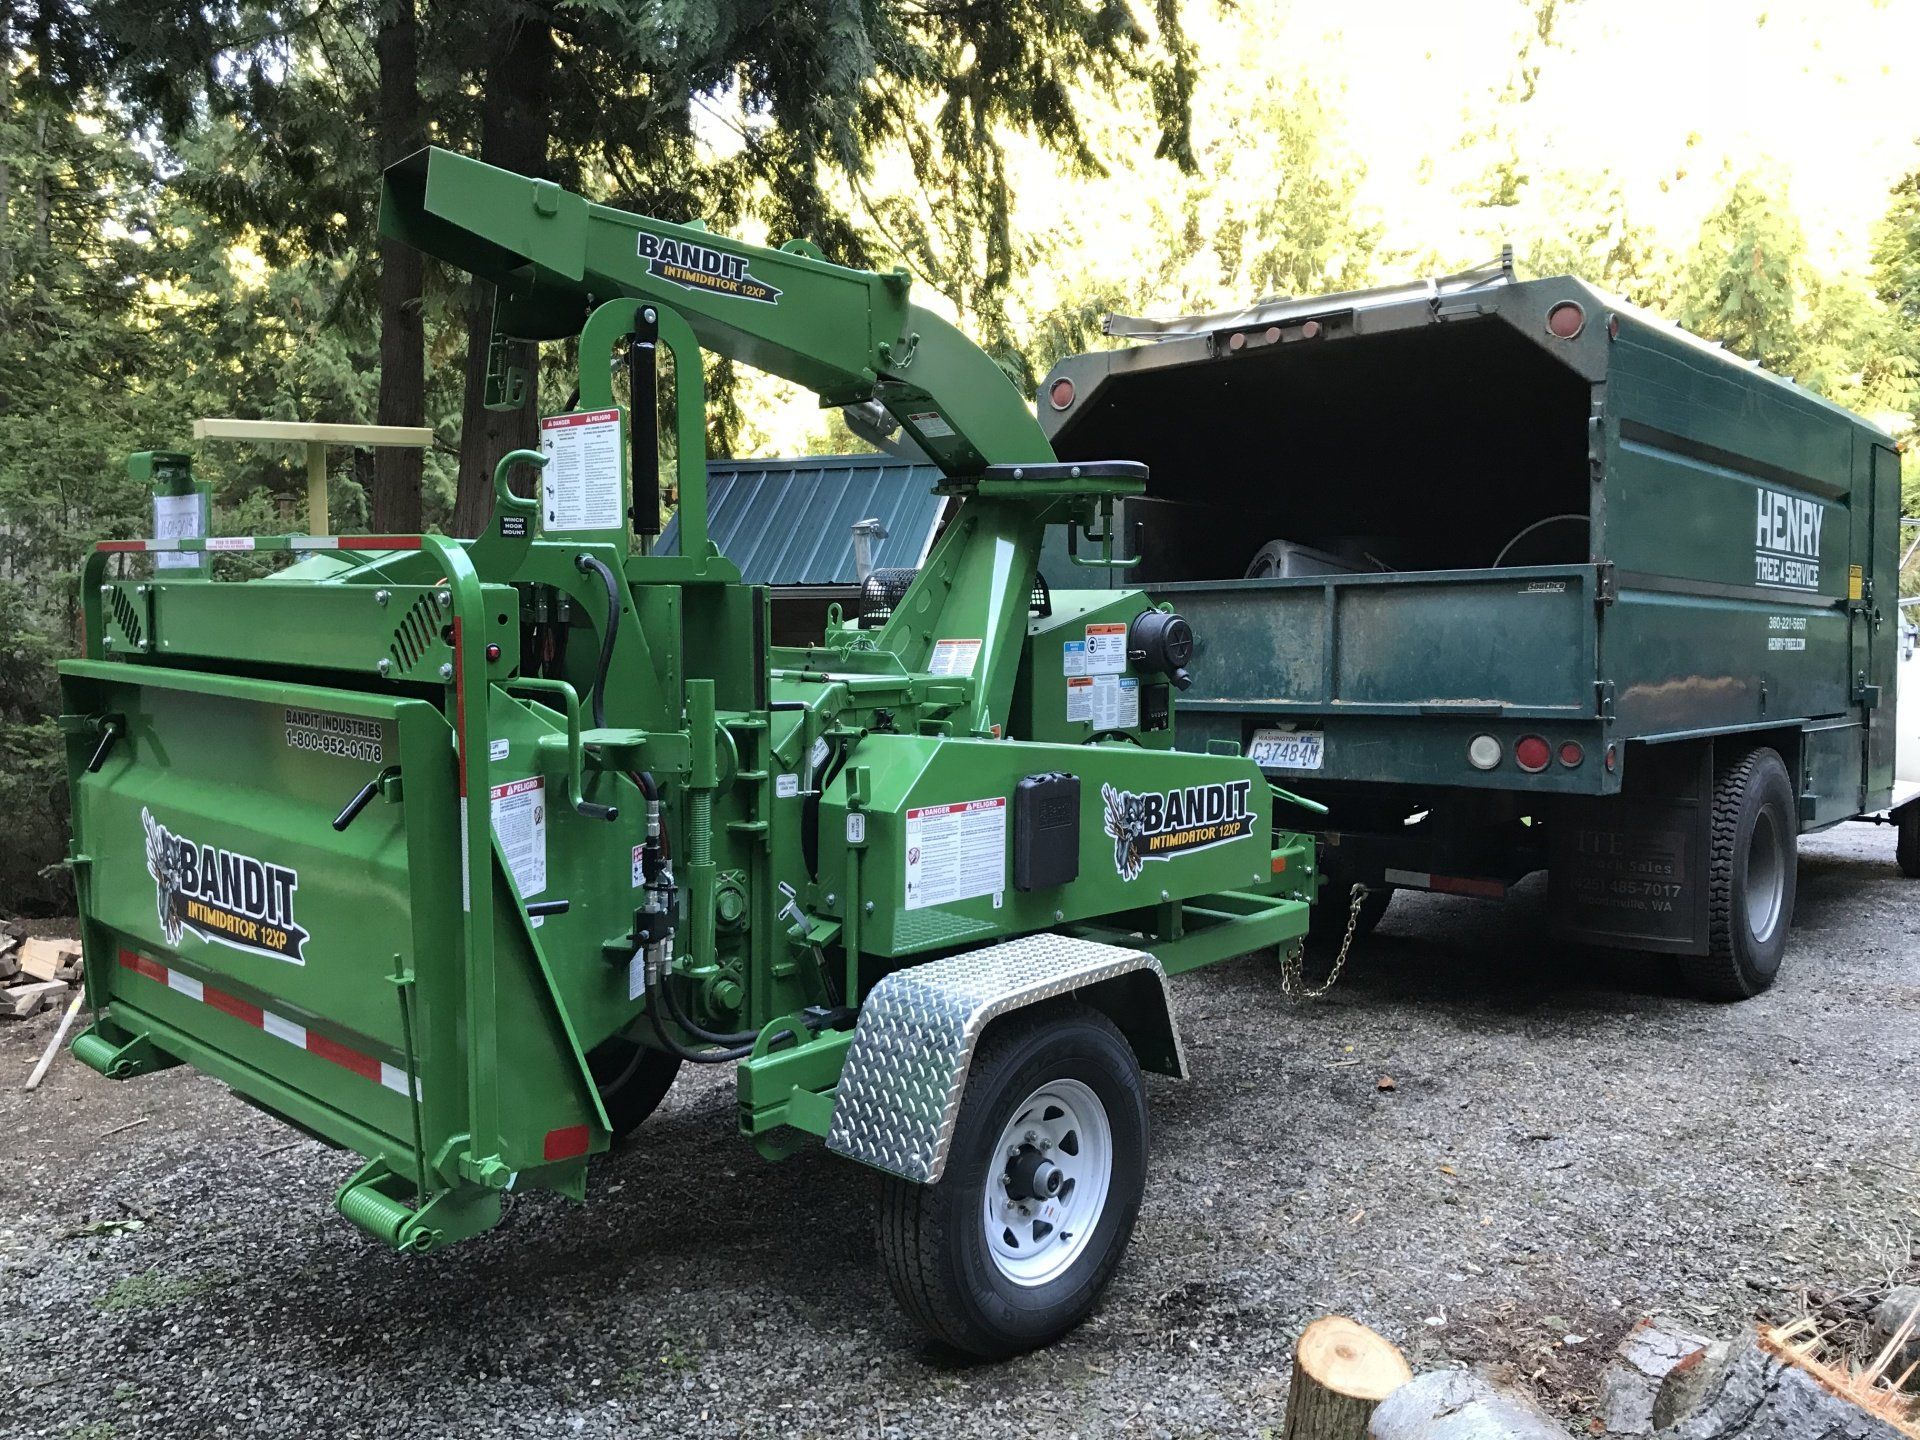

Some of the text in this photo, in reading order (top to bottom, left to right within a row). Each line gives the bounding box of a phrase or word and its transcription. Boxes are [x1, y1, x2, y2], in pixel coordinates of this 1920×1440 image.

[638, 232, 749, 281] BANDIT
[663, 265, 766, 298] INTIMIDATOR 12XP
[591, 413, 611, 422] PELIGRO
[1756, 488, 1825, 556] HENRY
[1756, 556, 1779, 581] TREE
[1785, 561, 1820, 587] SERVICE
[285, 709, 382, 740] BANDIT INDUSTRIES
[286, 730, 382, 763] 1-800-952-0178
[513, 779, 538, 794] PELIGRO
[924, 806, 951, 816] DANGER
[972, 800, 998, 809] PELIGRO
[1143, 779, 1251, 834] BANDIT
[1149, 822, 1241, 851] INTIMIDATOR 12XP
[1629, 860, 1672, 876] Sales
[179, 838, 297, 930] BANDIT
[1609, 880, 1683, 898] 485-7017
[1651, 900, 1673, 912] WA
[188, 900, 287, 950] INTIMIDATOR 12XP
